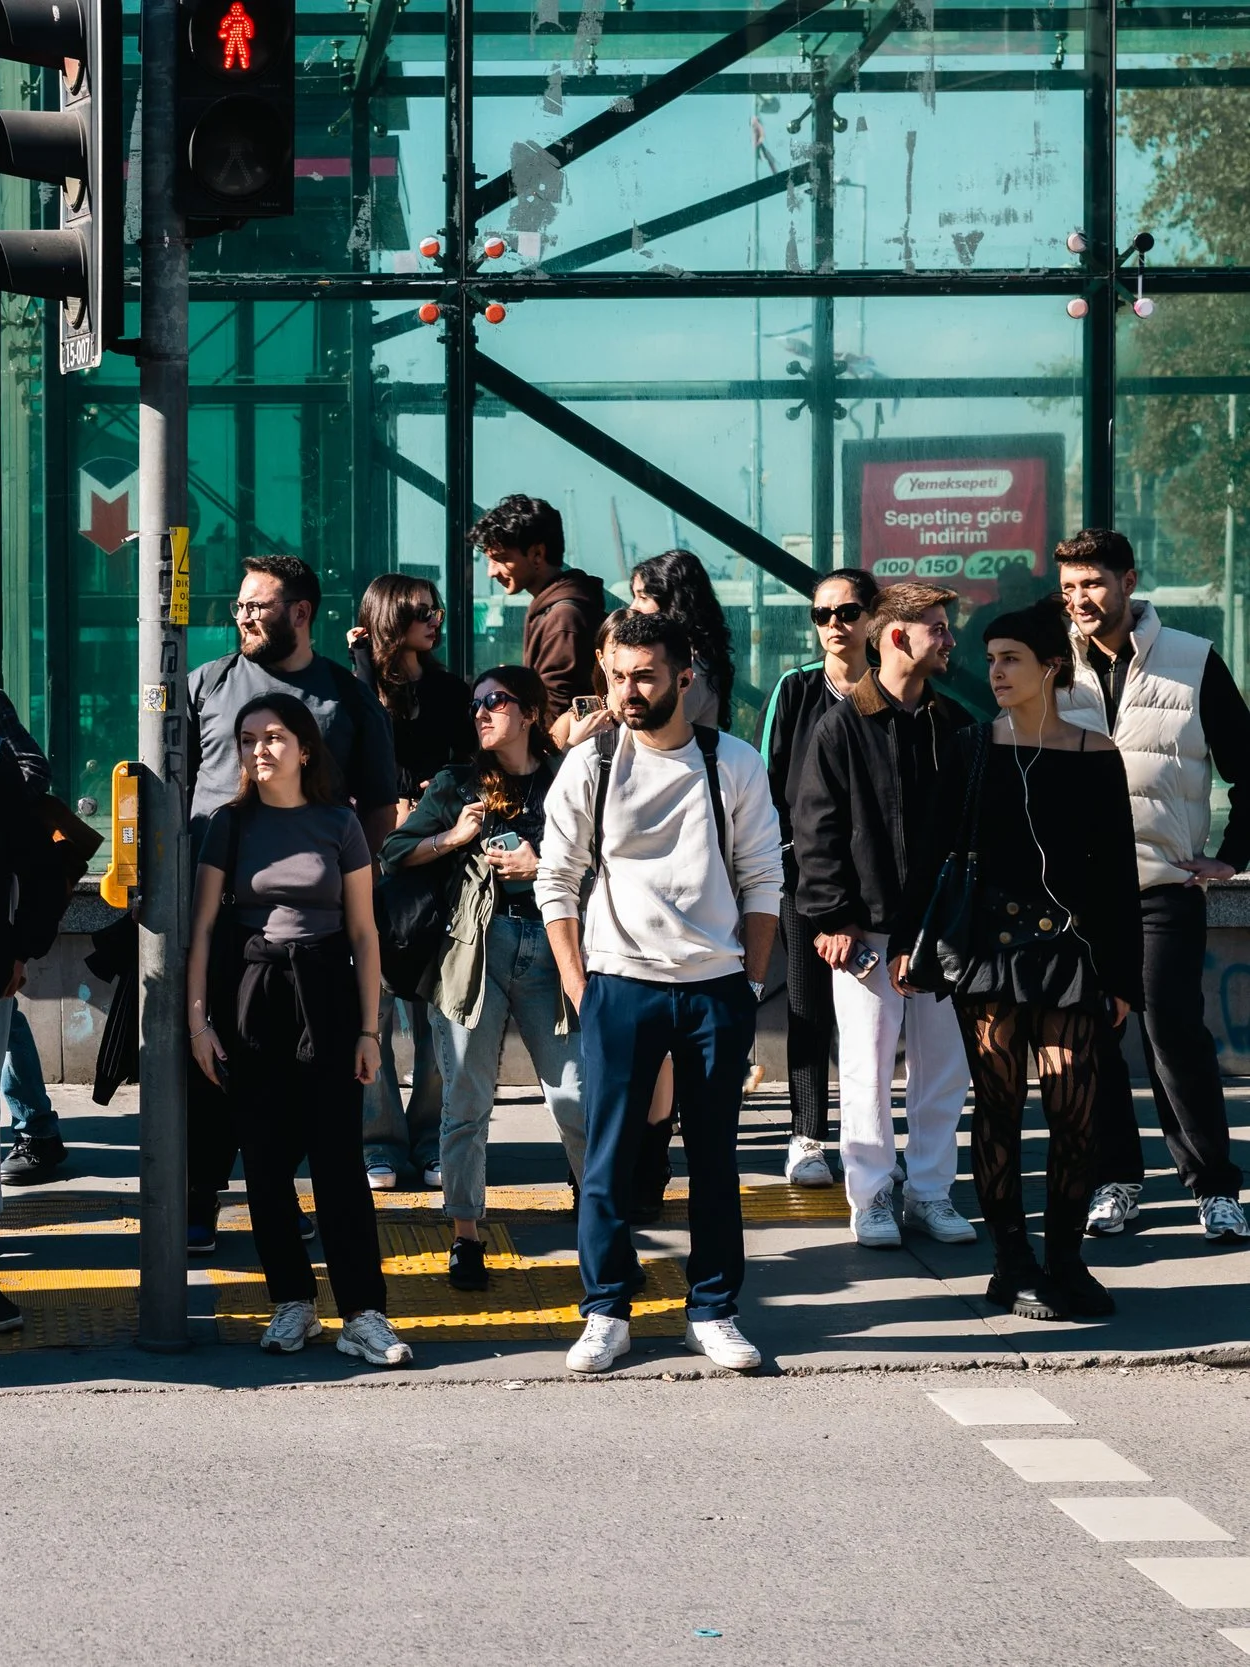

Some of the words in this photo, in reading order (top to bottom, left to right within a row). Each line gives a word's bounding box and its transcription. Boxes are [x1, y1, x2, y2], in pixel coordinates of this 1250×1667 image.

[65, 337, 91, 368] 15-007
[909, 476, 998, 492] Yemeksepeti
[884, 508, 973, 529] Sepetine
[977, 507, 1023, 528] göre
[920, 526, 988, 545] indirim
